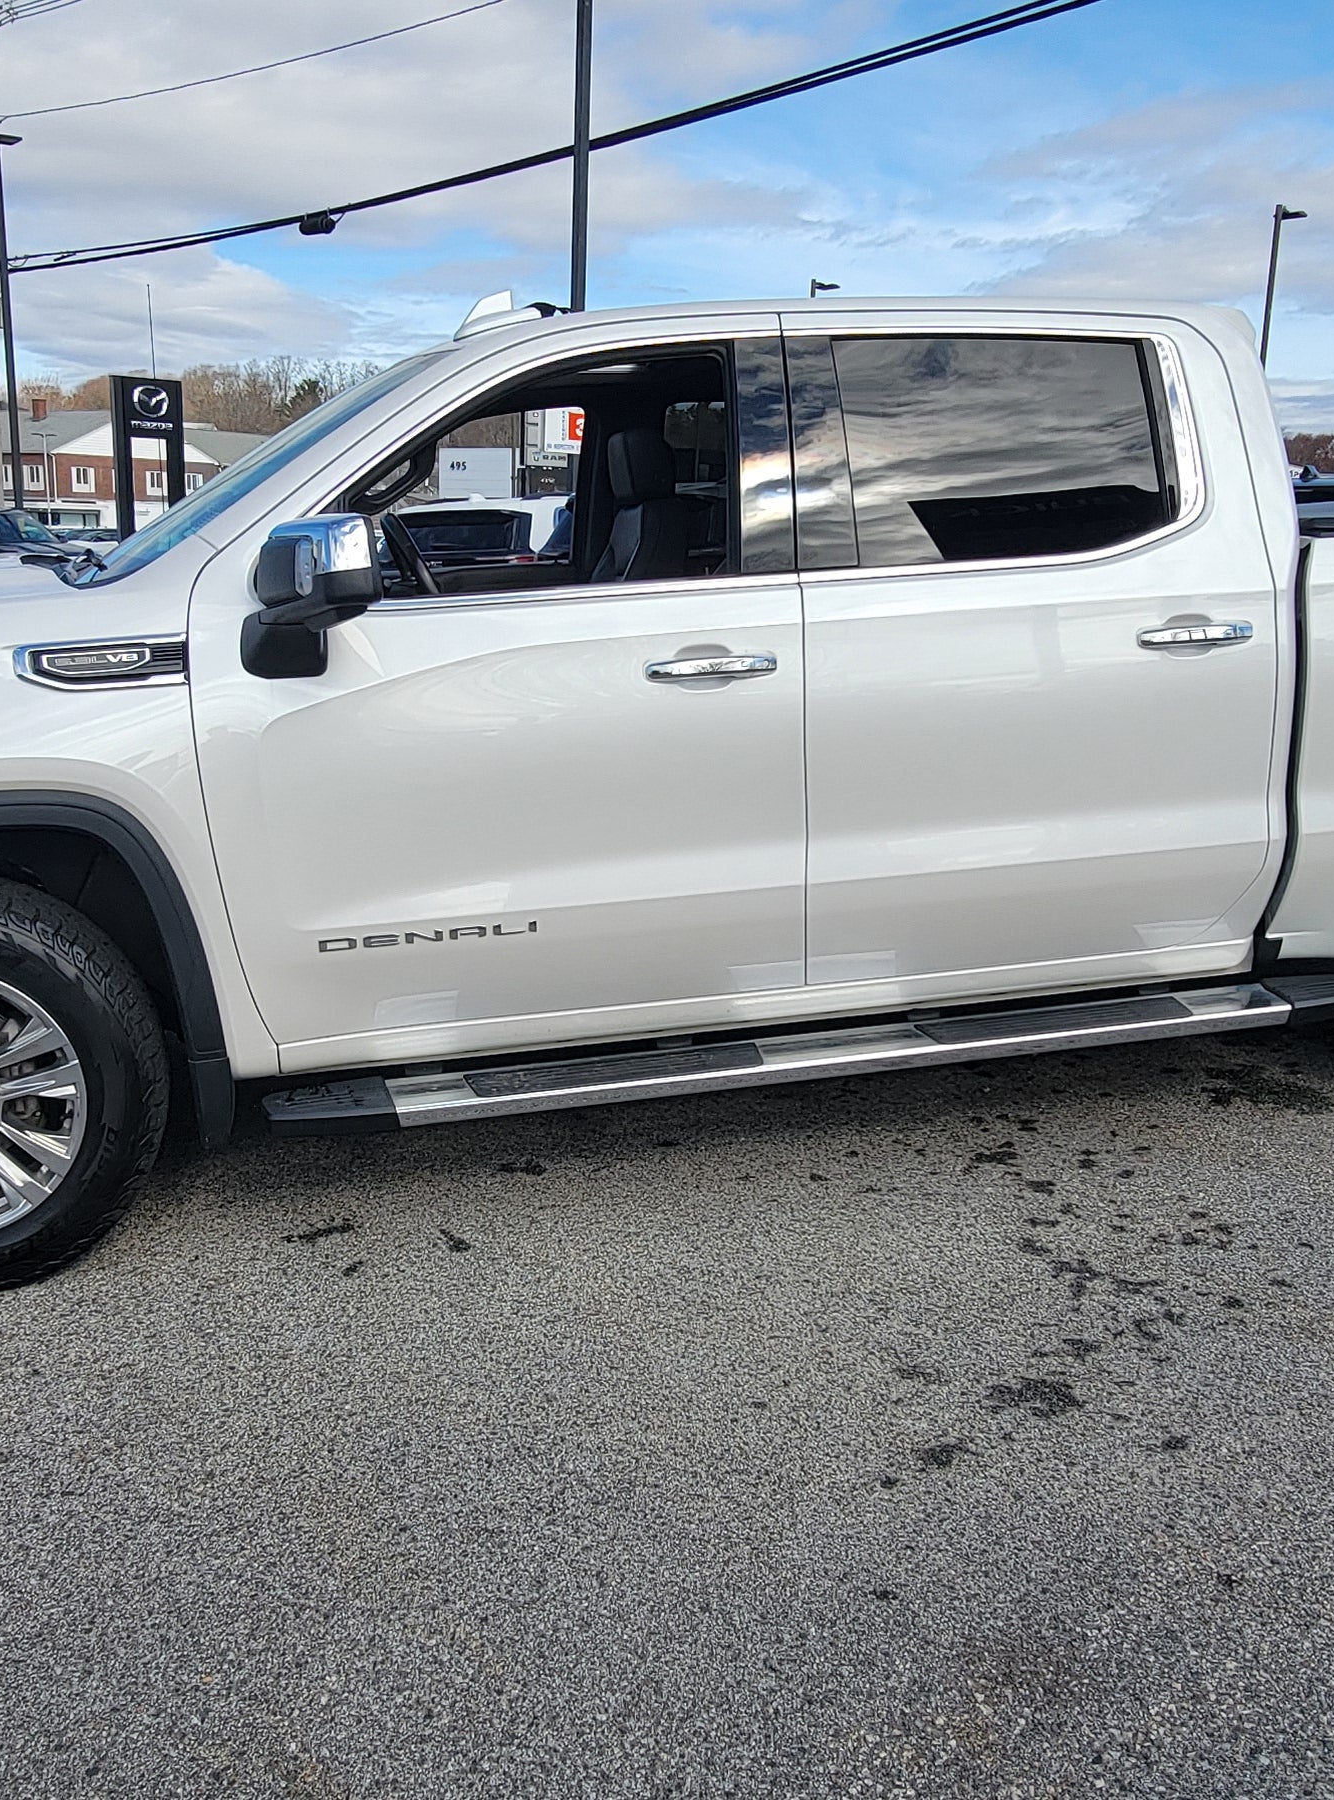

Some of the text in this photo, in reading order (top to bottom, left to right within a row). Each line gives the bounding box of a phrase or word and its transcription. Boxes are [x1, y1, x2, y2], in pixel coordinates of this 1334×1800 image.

[131, 420, 173, 431] mazda
[449, 461, 467, 471] 495
[318, 920, 537, 952] DENALI
